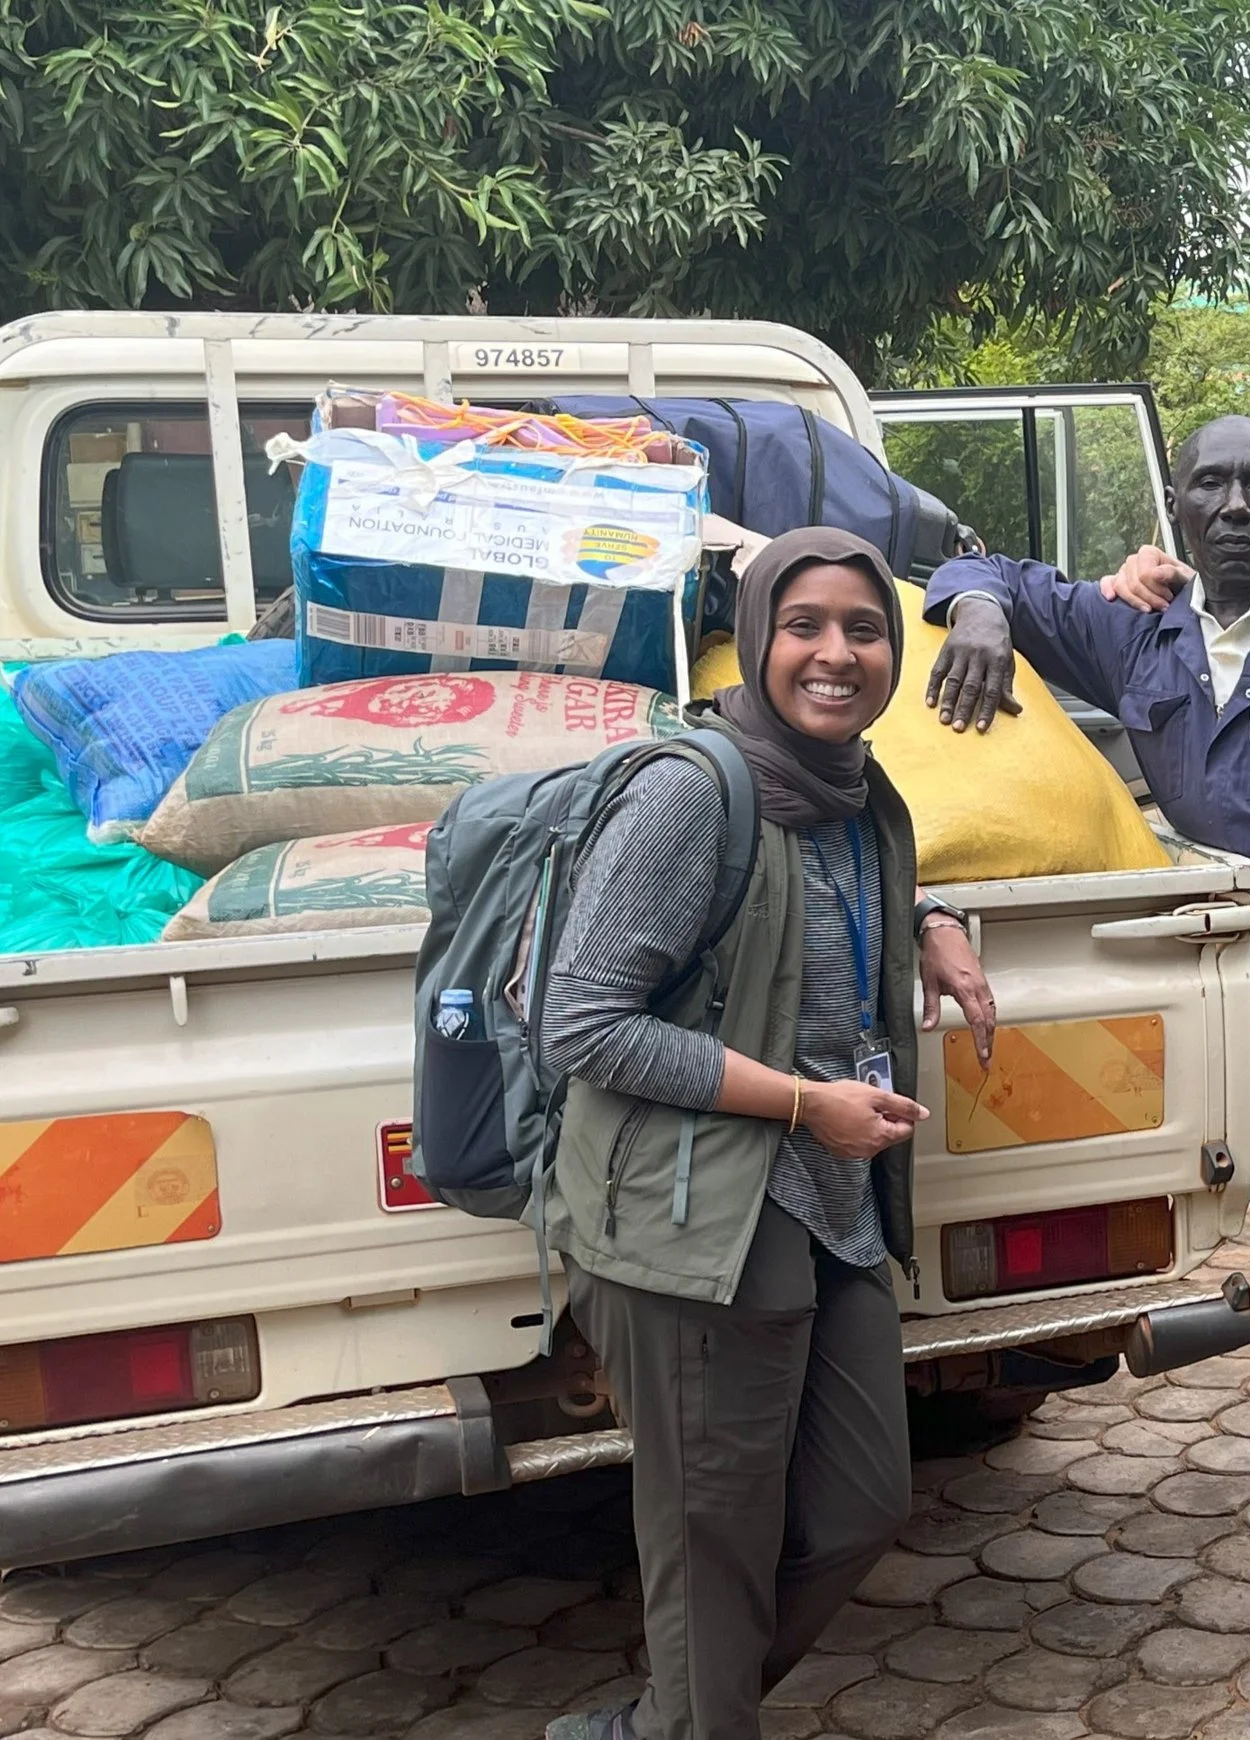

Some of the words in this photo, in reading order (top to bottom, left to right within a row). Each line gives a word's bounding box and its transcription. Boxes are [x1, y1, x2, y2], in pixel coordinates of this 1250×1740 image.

[475, 348, 564, 367] 974857
[351, 503, 549, 534] AUSRALIA
[472, 532, 549, 551] MEDICAL
[583, 528, 638, 541] HUMANITY
[472, 548, 549, 570] GLOBAL
[137, 669, 182, 712] GROUP
[565, 680, 600, 732] GAR
[603, 681, 640, 744] KIRA
